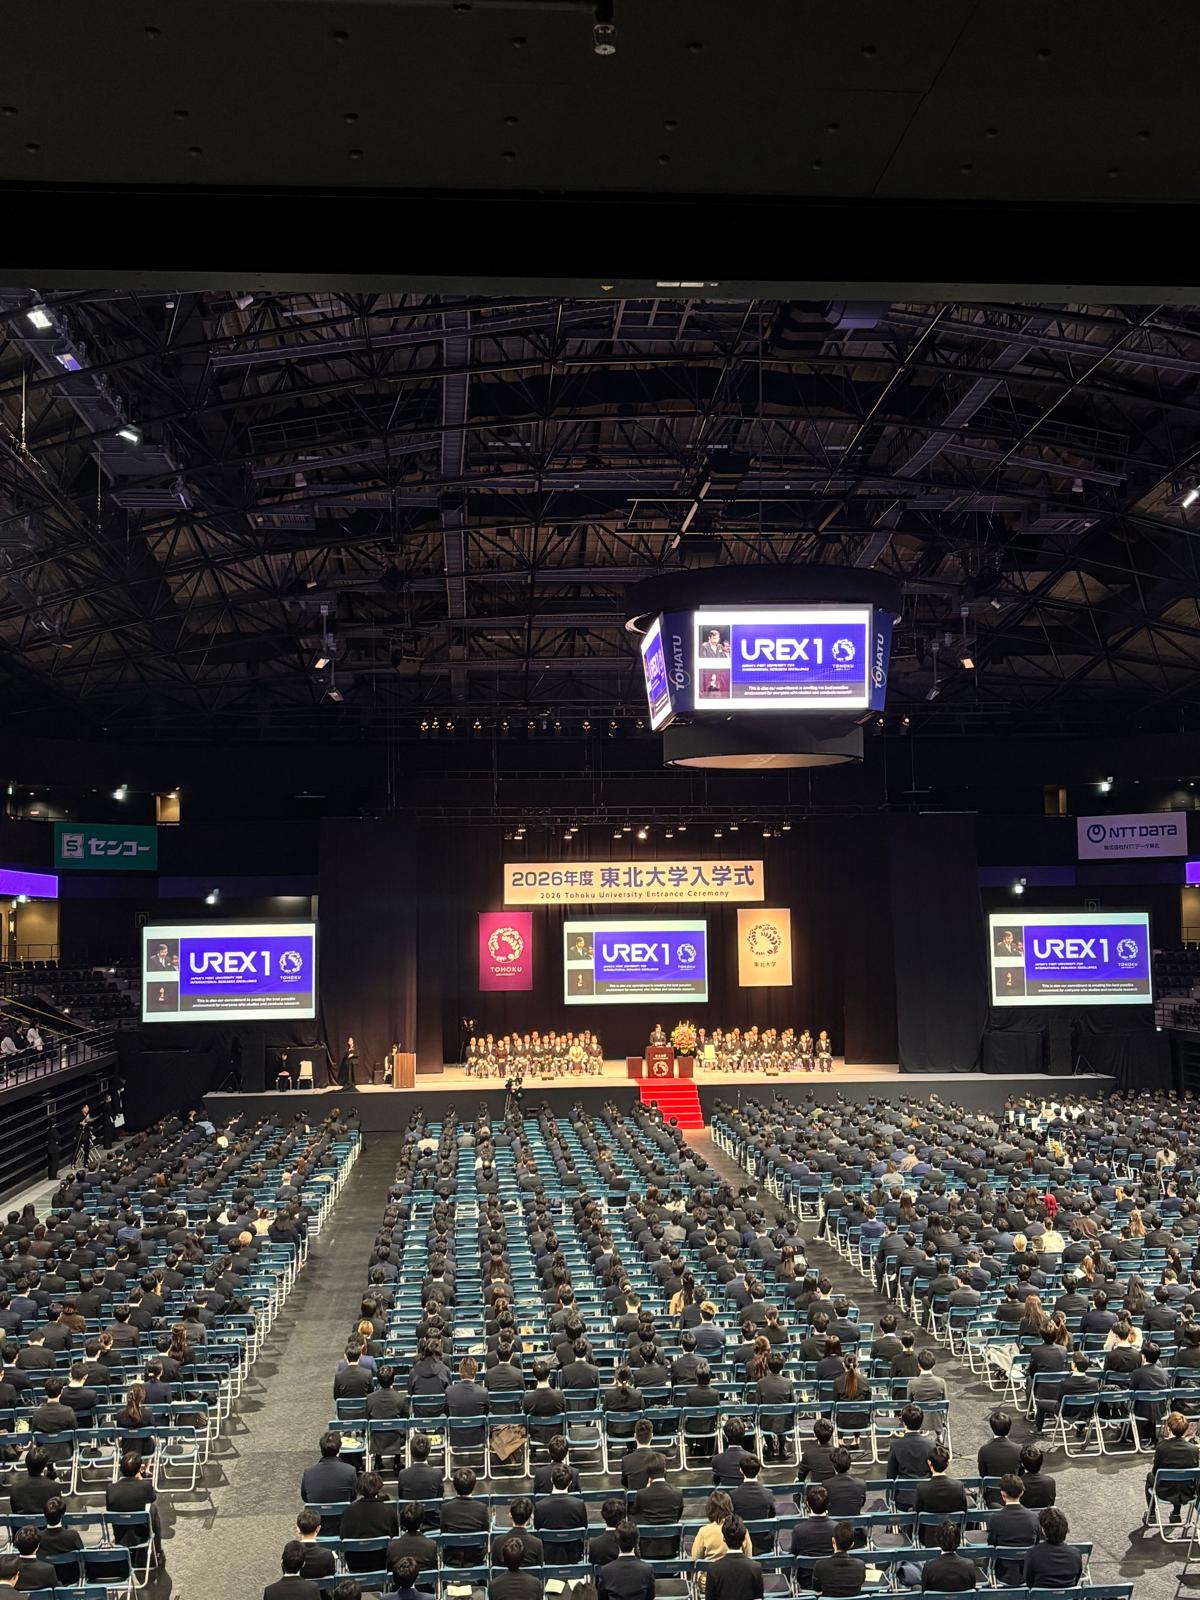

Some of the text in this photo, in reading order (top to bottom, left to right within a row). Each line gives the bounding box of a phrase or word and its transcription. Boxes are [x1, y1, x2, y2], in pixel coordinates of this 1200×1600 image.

[672, 636, 684, 690] TOHATU
[875, 633, 884, 688] TOHATU
[1110, 827, 1136, 838] NTT
[88, 838, 150, 855] センコー
[512, 865, 754, 888] 2026年度 東北大学入学式
